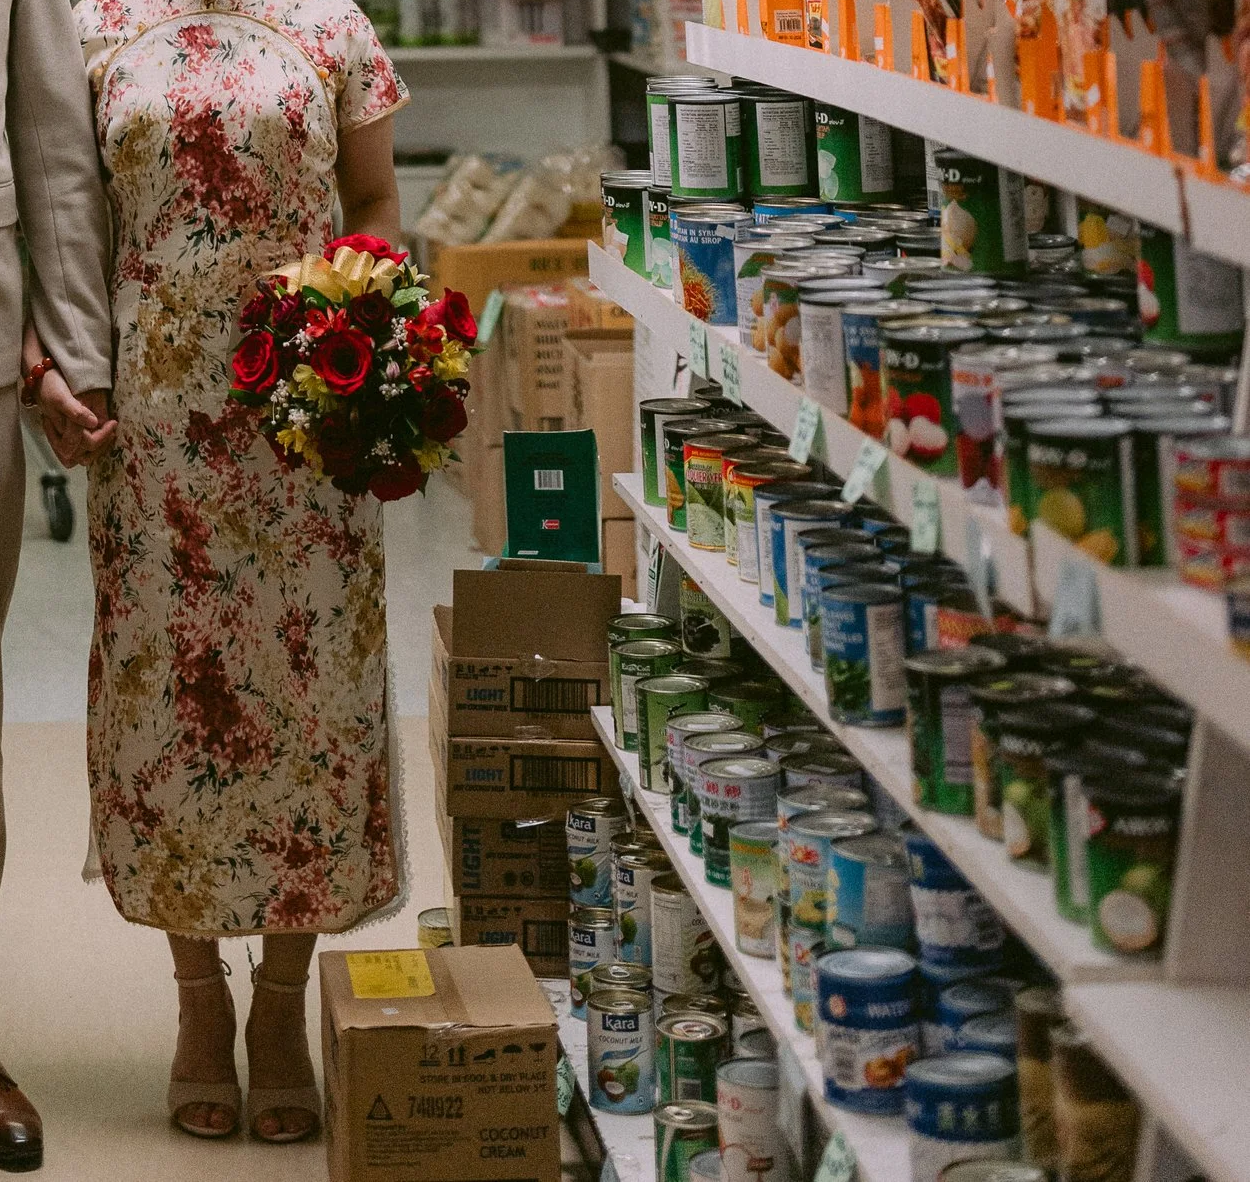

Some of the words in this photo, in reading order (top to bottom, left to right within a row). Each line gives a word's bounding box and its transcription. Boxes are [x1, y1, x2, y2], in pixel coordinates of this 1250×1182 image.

[689, 228, 696, 236] IN
[698, 229, 716, 237] SYRU
[701, 237, 722, 245] SIROP
[466, 688, 505, 702] LIGHT
[616, 872, 631, 884] ara
[605, 1015, 636, 1031] kara
[599, 1034, 628, 1045] COCONUT
[629, 1036, 643, 1045] MILK
[477, 1084, 497, 1094] NOT
[499, 1083, 531, 1094] BELOW
[479, 1124, 550, 1142] COCONUT
[479, 1144, 527, 1160] CREAM
